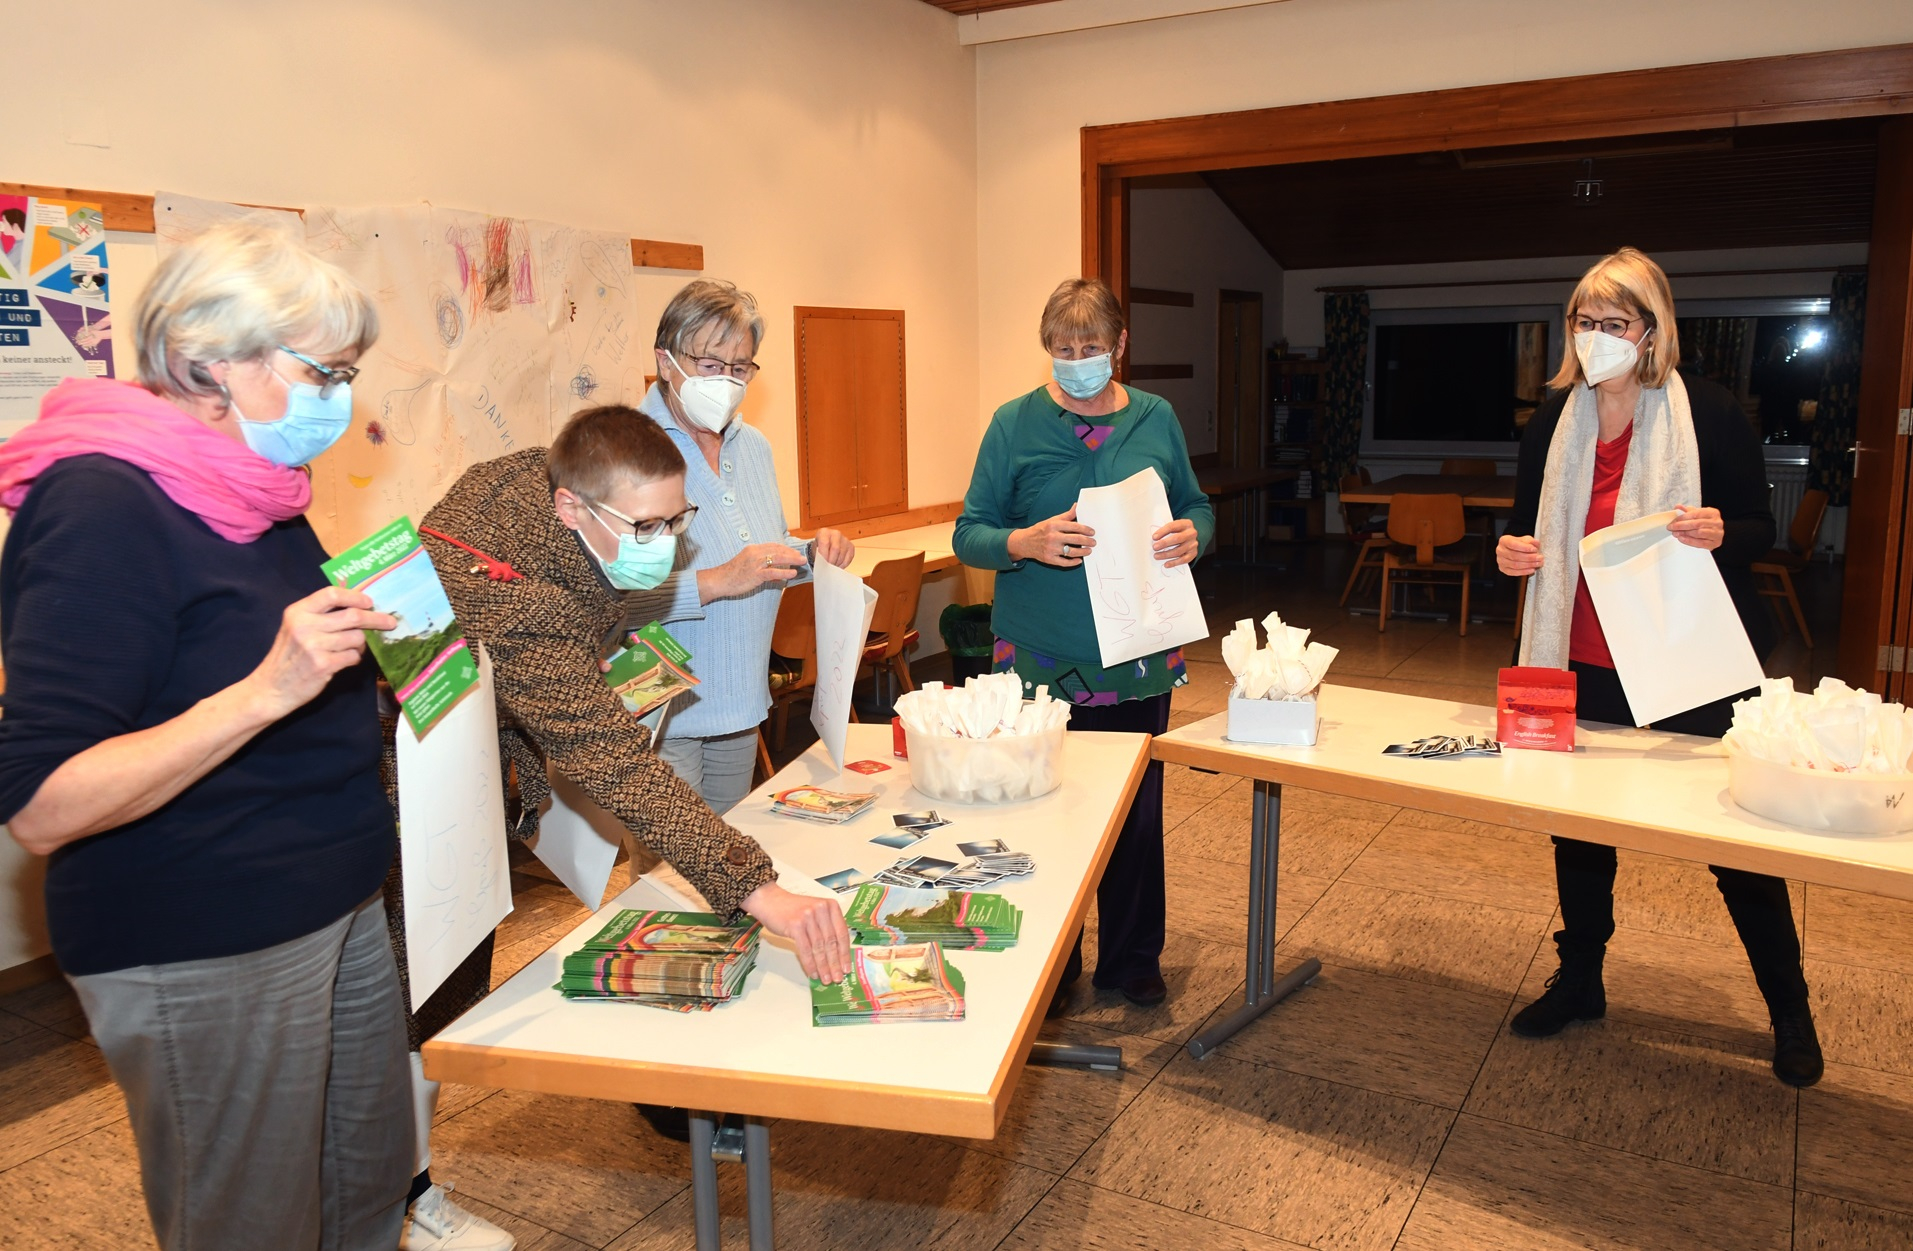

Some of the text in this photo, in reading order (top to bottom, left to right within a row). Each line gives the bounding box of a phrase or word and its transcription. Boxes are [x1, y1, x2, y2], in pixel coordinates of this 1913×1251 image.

[8, 312, 33, 323] UND
[2, 355, 73, 364] keiner ansteckt!
[472, 384, 515, 451] DANKE
[332, 529, 413, 581] Weltgebetstag
[830, 637, 847, 705] 2022
[1514, 730, 1557, 740] English Breakfast
